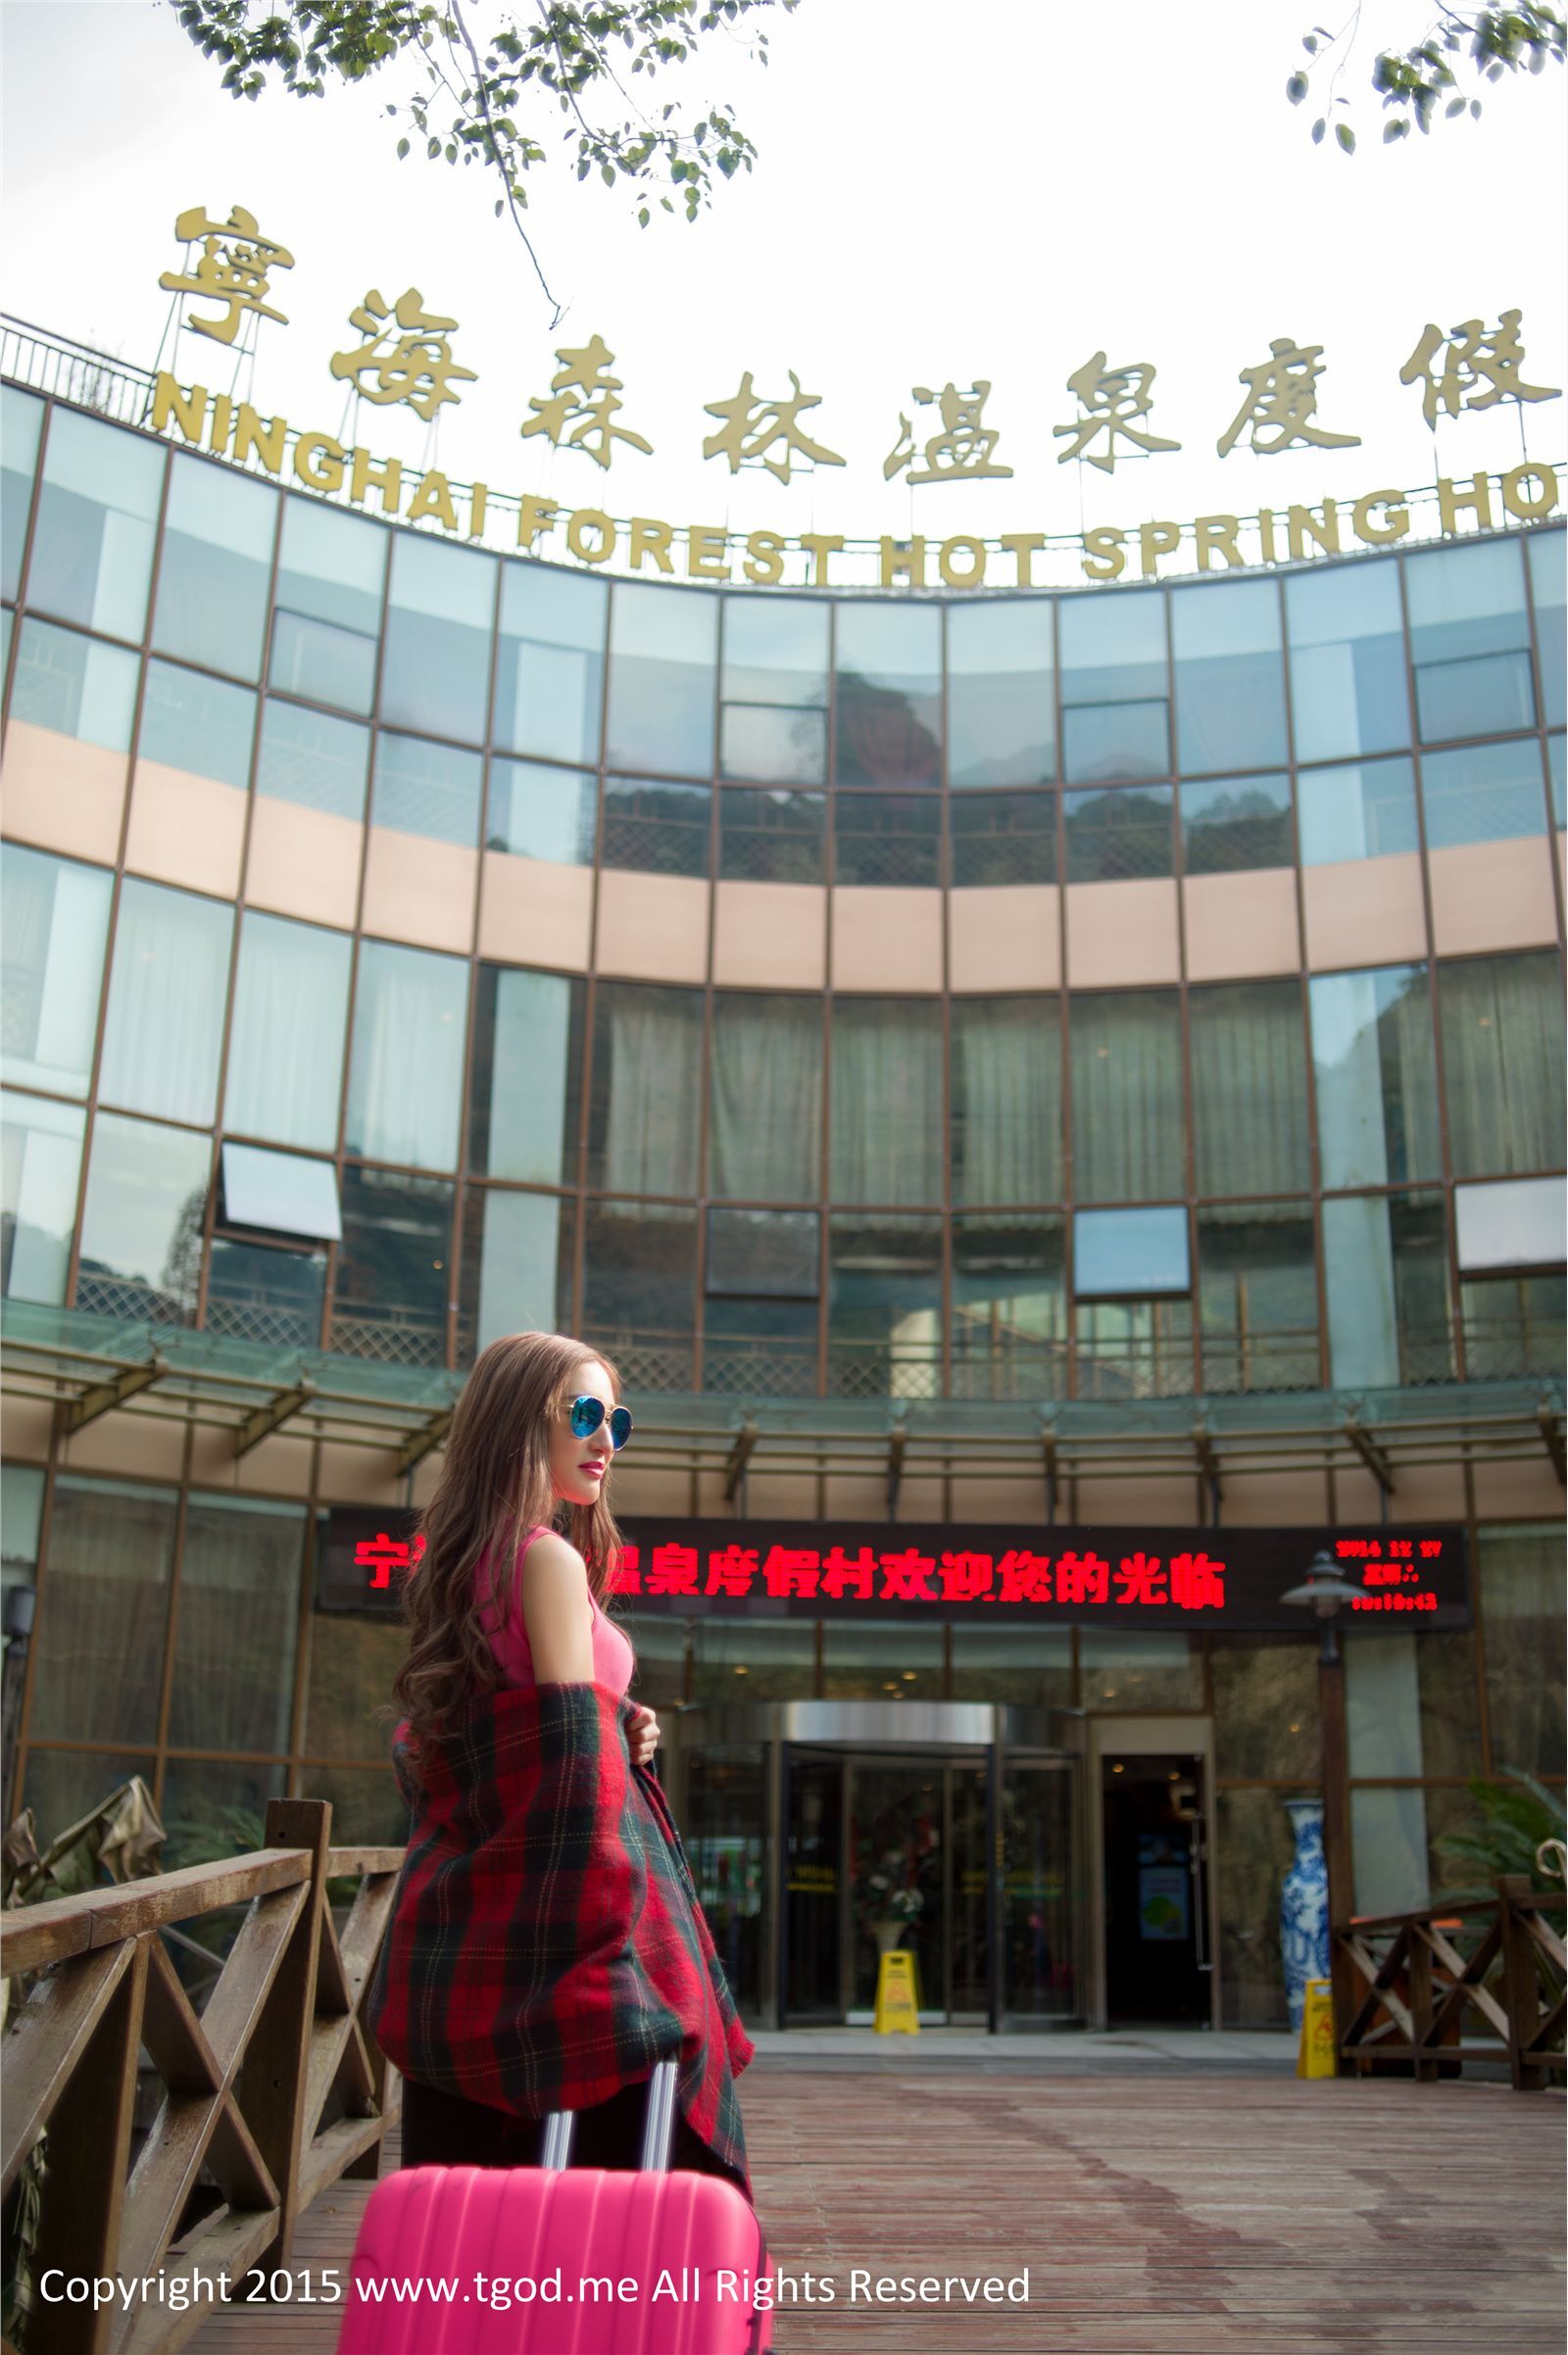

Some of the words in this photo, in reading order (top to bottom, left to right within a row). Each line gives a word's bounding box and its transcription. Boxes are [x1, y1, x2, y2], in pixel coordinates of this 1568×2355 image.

[152, 371, 489, 538] NINGHAI
[516, 493, 845, 587] FOREST
[880, 532, 1045, 588] HOT
[1082, 489, 1411, 580] SPRING
